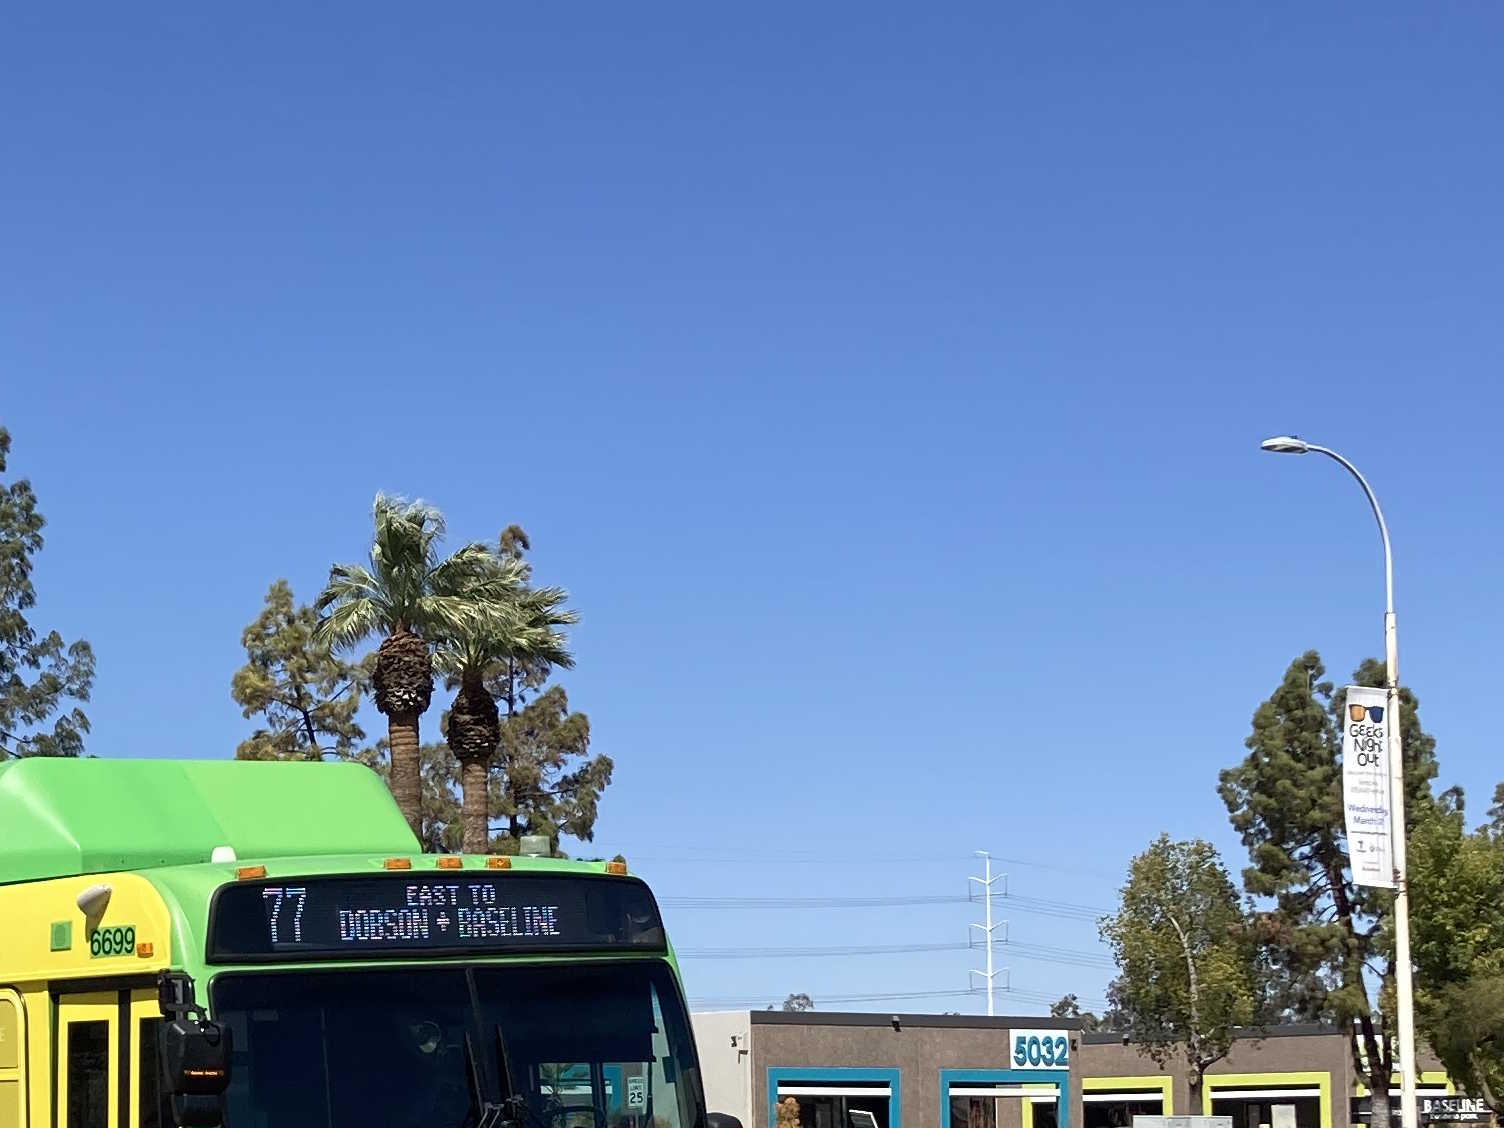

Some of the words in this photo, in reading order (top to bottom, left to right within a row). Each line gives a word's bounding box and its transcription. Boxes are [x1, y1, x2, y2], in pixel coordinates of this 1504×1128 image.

[406, 885, 459, 906] EAST
[468, 885, 496, 905] TO
[263, 887, 306, 942] 77
[339, 908, 430, 941] DOBSON
[458, 906, 560, 938] BASELINE
[90, 927, 136, 956] 6699
[1013, 1035, 1069, 1067] 5032
[630, 1091, 644, 1104] 25
[1423, 1098, 1485, 1114] BASELINE
